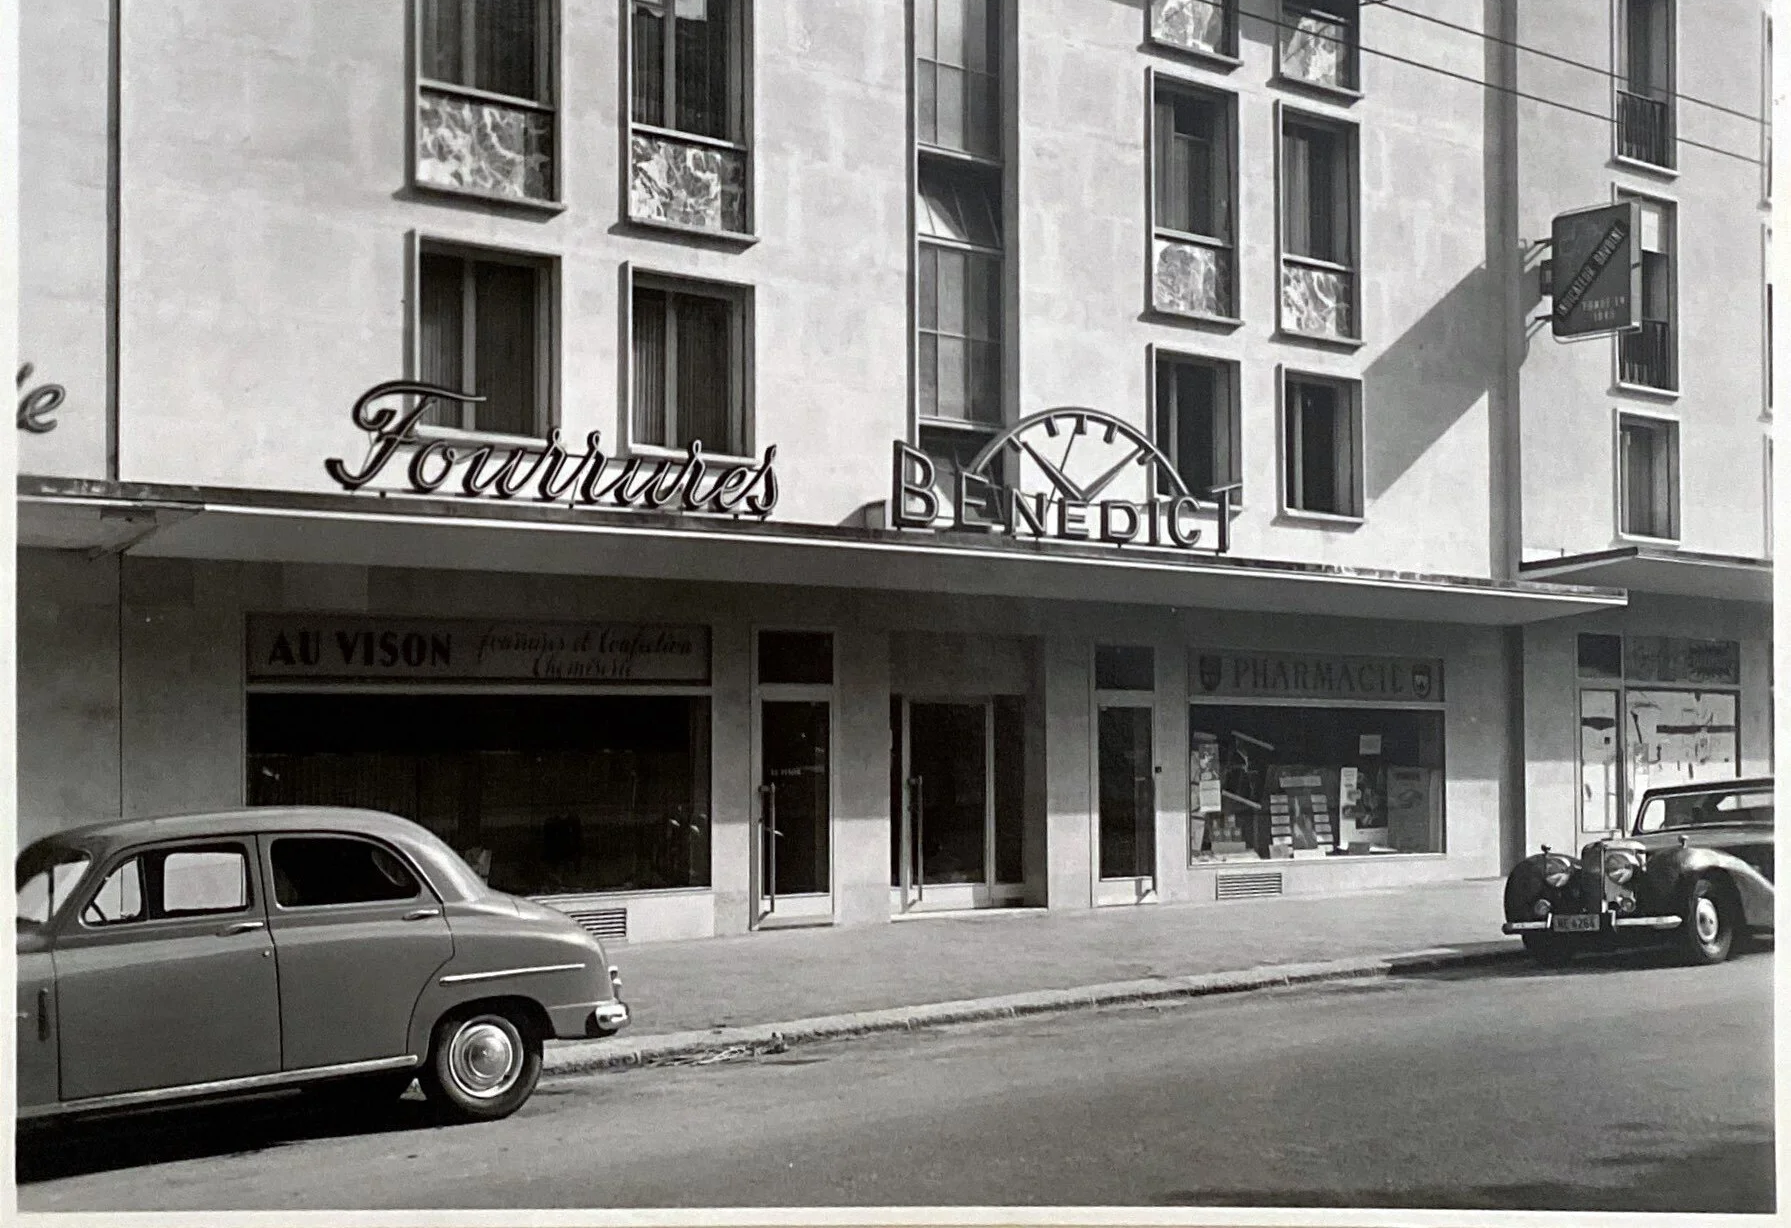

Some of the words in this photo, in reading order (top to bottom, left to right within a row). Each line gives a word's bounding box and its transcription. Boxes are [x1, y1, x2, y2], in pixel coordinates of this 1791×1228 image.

[325, 379, 781, 516] Fourrures
[892, 439, 1243, 553] BENEDICT
[268, 630, 320, 666] AU
[335, 630, 452, 667] VISON
